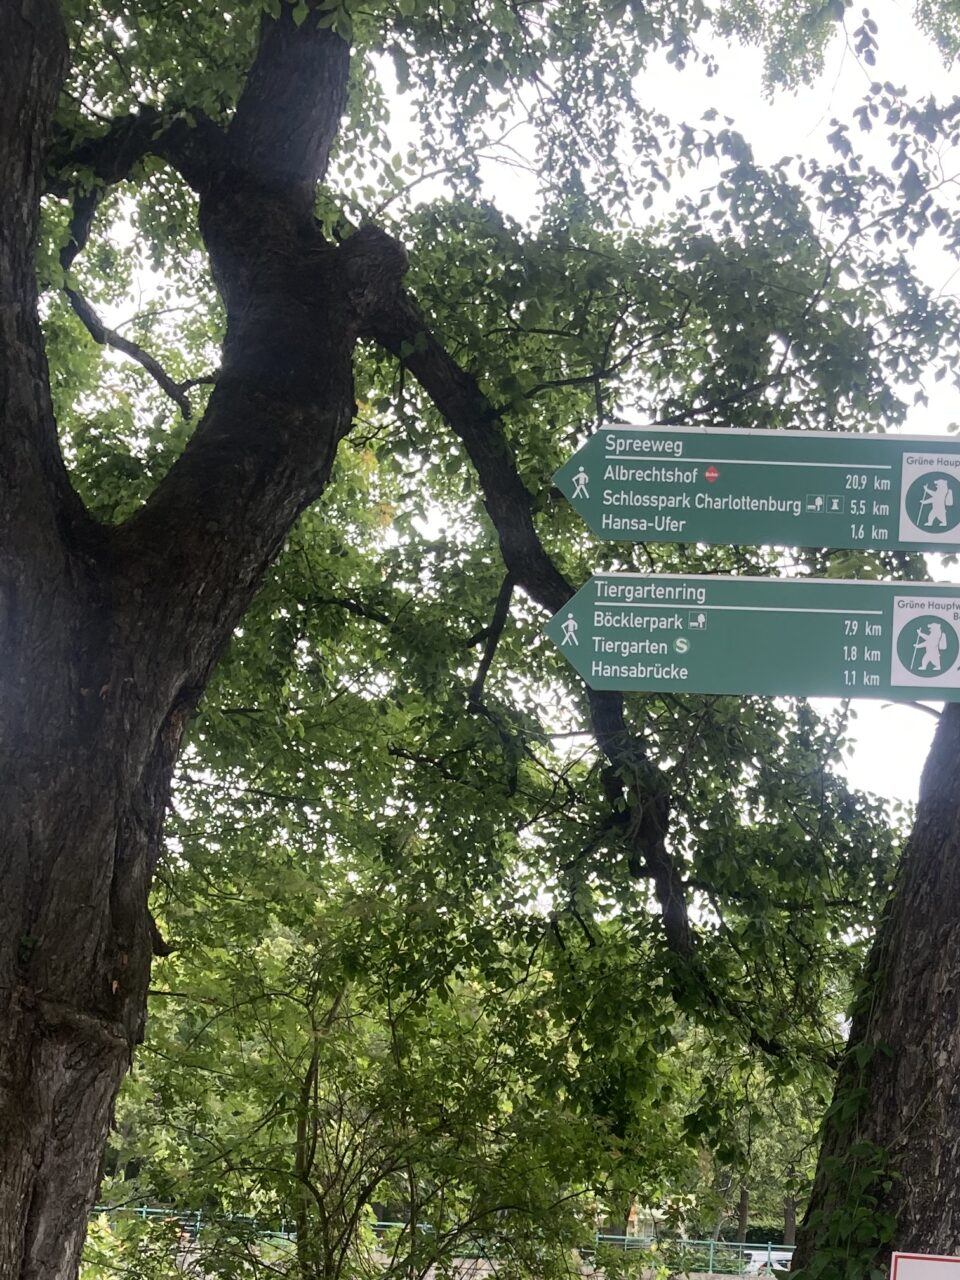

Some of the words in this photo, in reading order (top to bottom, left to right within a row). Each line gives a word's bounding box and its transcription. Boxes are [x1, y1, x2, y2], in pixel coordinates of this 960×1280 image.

[605, 435, 683, 456] Spreeweg
[906, 456, 935, 468] Grüne
[604, 465, 698, 483] Albrechtshof
[873, 476, 891, 490] km
[603, 490, 692, 512] Schlosspark
[695, 494, 801, 516] Charlottenburg
[850, 501, 866, 516] 5,5
[872, 501, 889, 516] km
[601, 514, 686, 532] Hansa-Ufer
[850, 525, 865, 540] 1,6
[871, 526, 888, 540] km
[594, 581, 706, 604] Tiergartenring
[897, 600, 926, 611] Grüne
[593, 611, 683, 634] Böcklerpark
[865, 621, 882, 636] km
[592, 637, 668, 657] Tiergarten
[843, 646, 858, 661] 1,8
[863, 646, 881, 661] km
[591, 660, 688, 680] Hansabrücke
[863, 671, 880, 686] km
